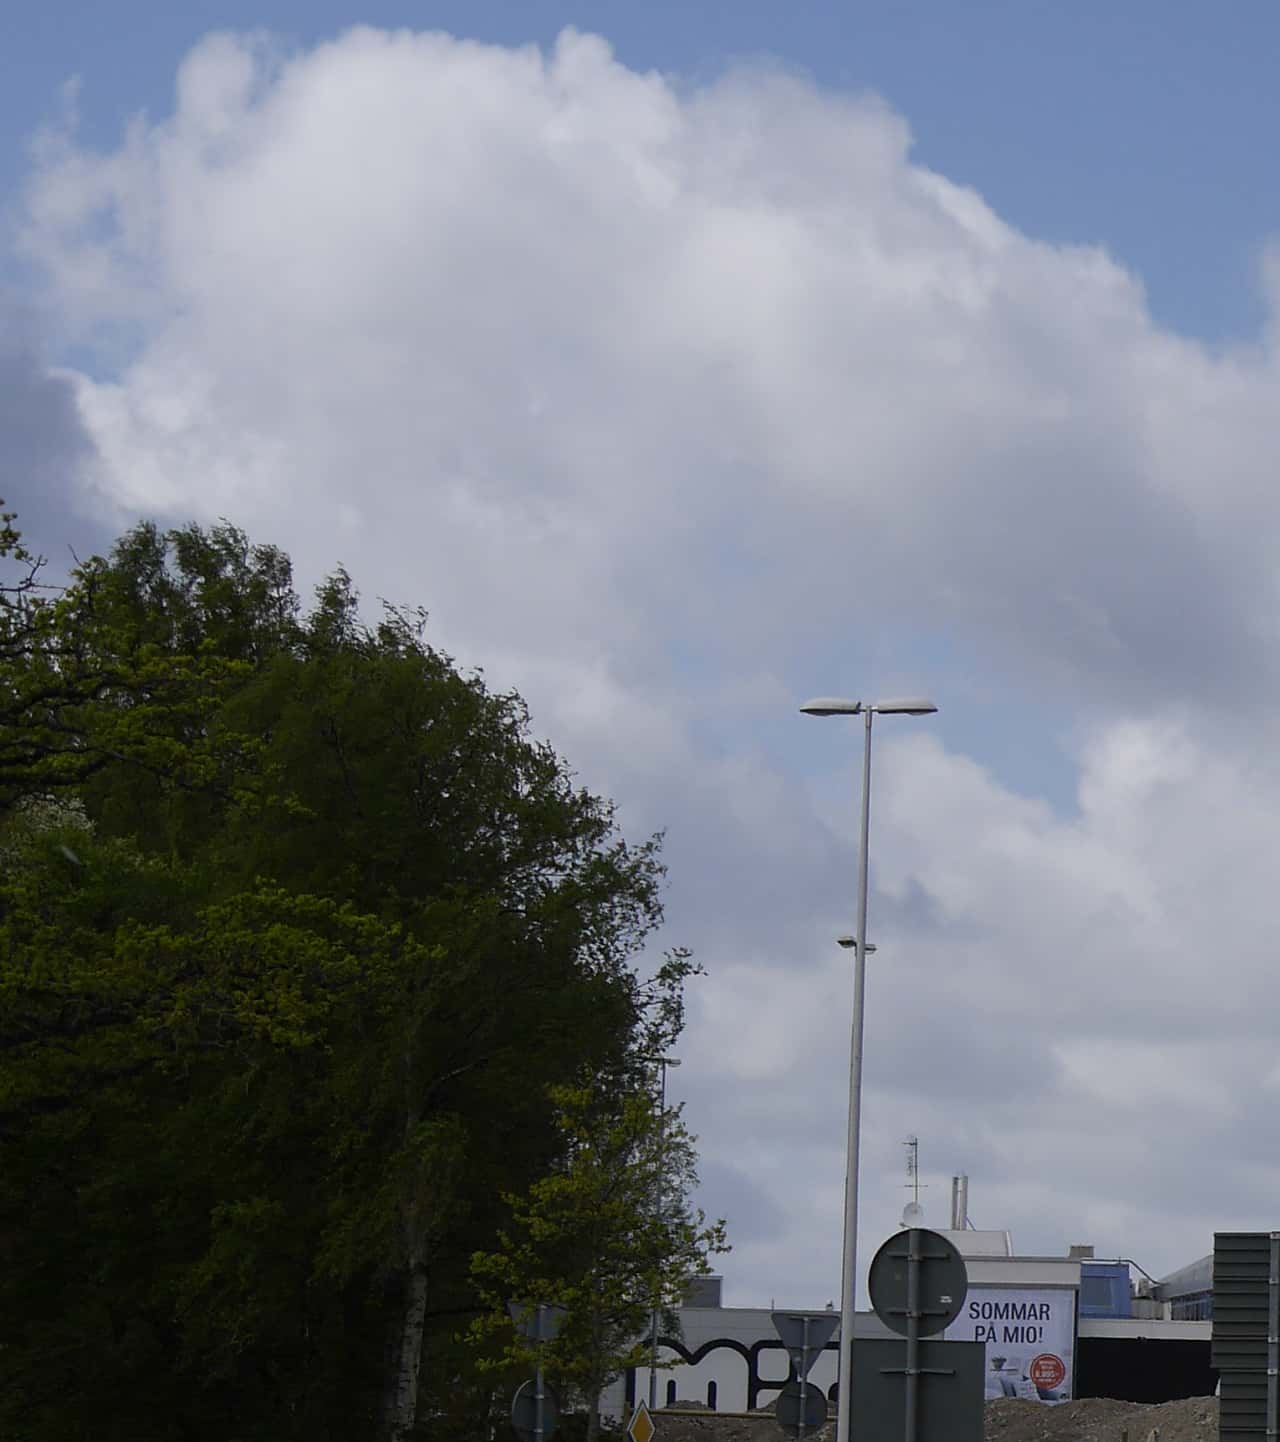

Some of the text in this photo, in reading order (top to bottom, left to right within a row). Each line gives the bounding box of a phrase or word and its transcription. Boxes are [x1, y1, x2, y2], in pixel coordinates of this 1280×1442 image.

[968, 1301, 1051, 1321] SOMMAR
[974, 1321, 1044, 1344] PÅ MIO!
